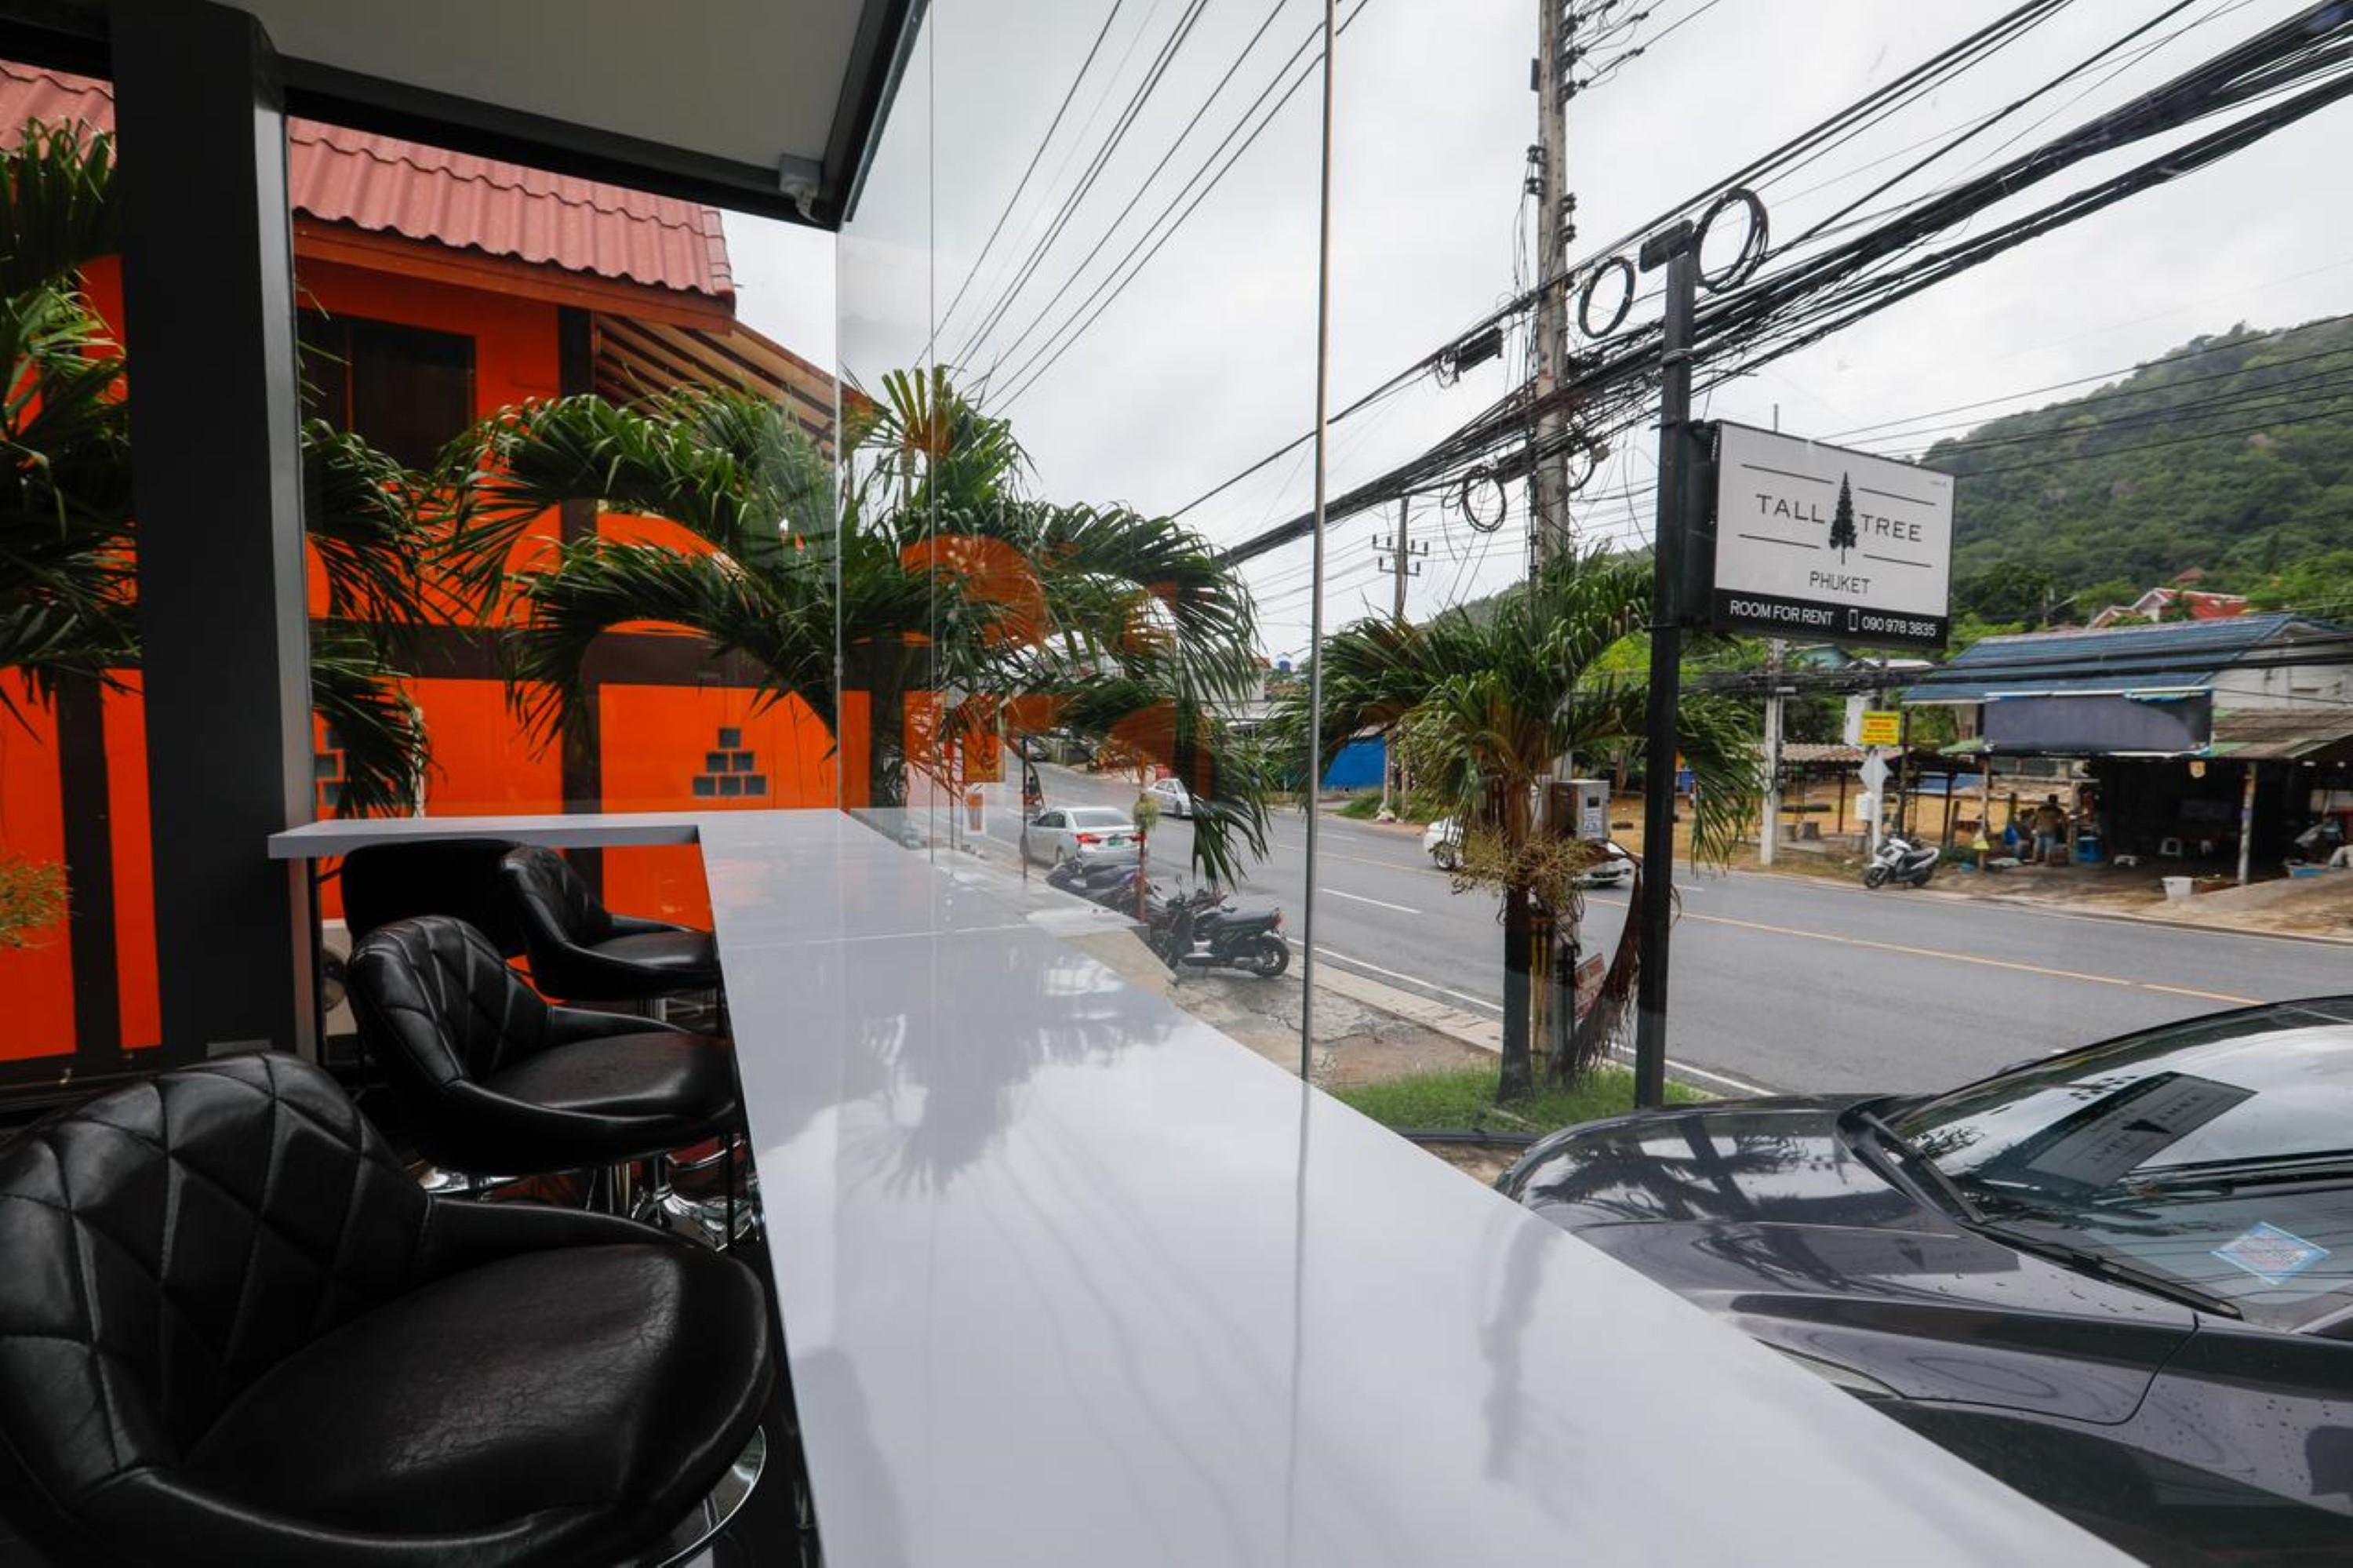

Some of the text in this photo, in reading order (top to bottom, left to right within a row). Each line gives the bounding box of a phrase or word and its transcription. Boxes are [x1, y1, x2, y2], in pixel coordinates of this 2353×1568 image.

[1755, 493, 1922, 542] TALL TREE
[1809, 570, 1870, 594] PHUKET
[1730, 600, 1835, 625] ROOM FOR RENT
[1861, 616, 1883, 631] 090
[1885, 618, 1906, 634] 978
